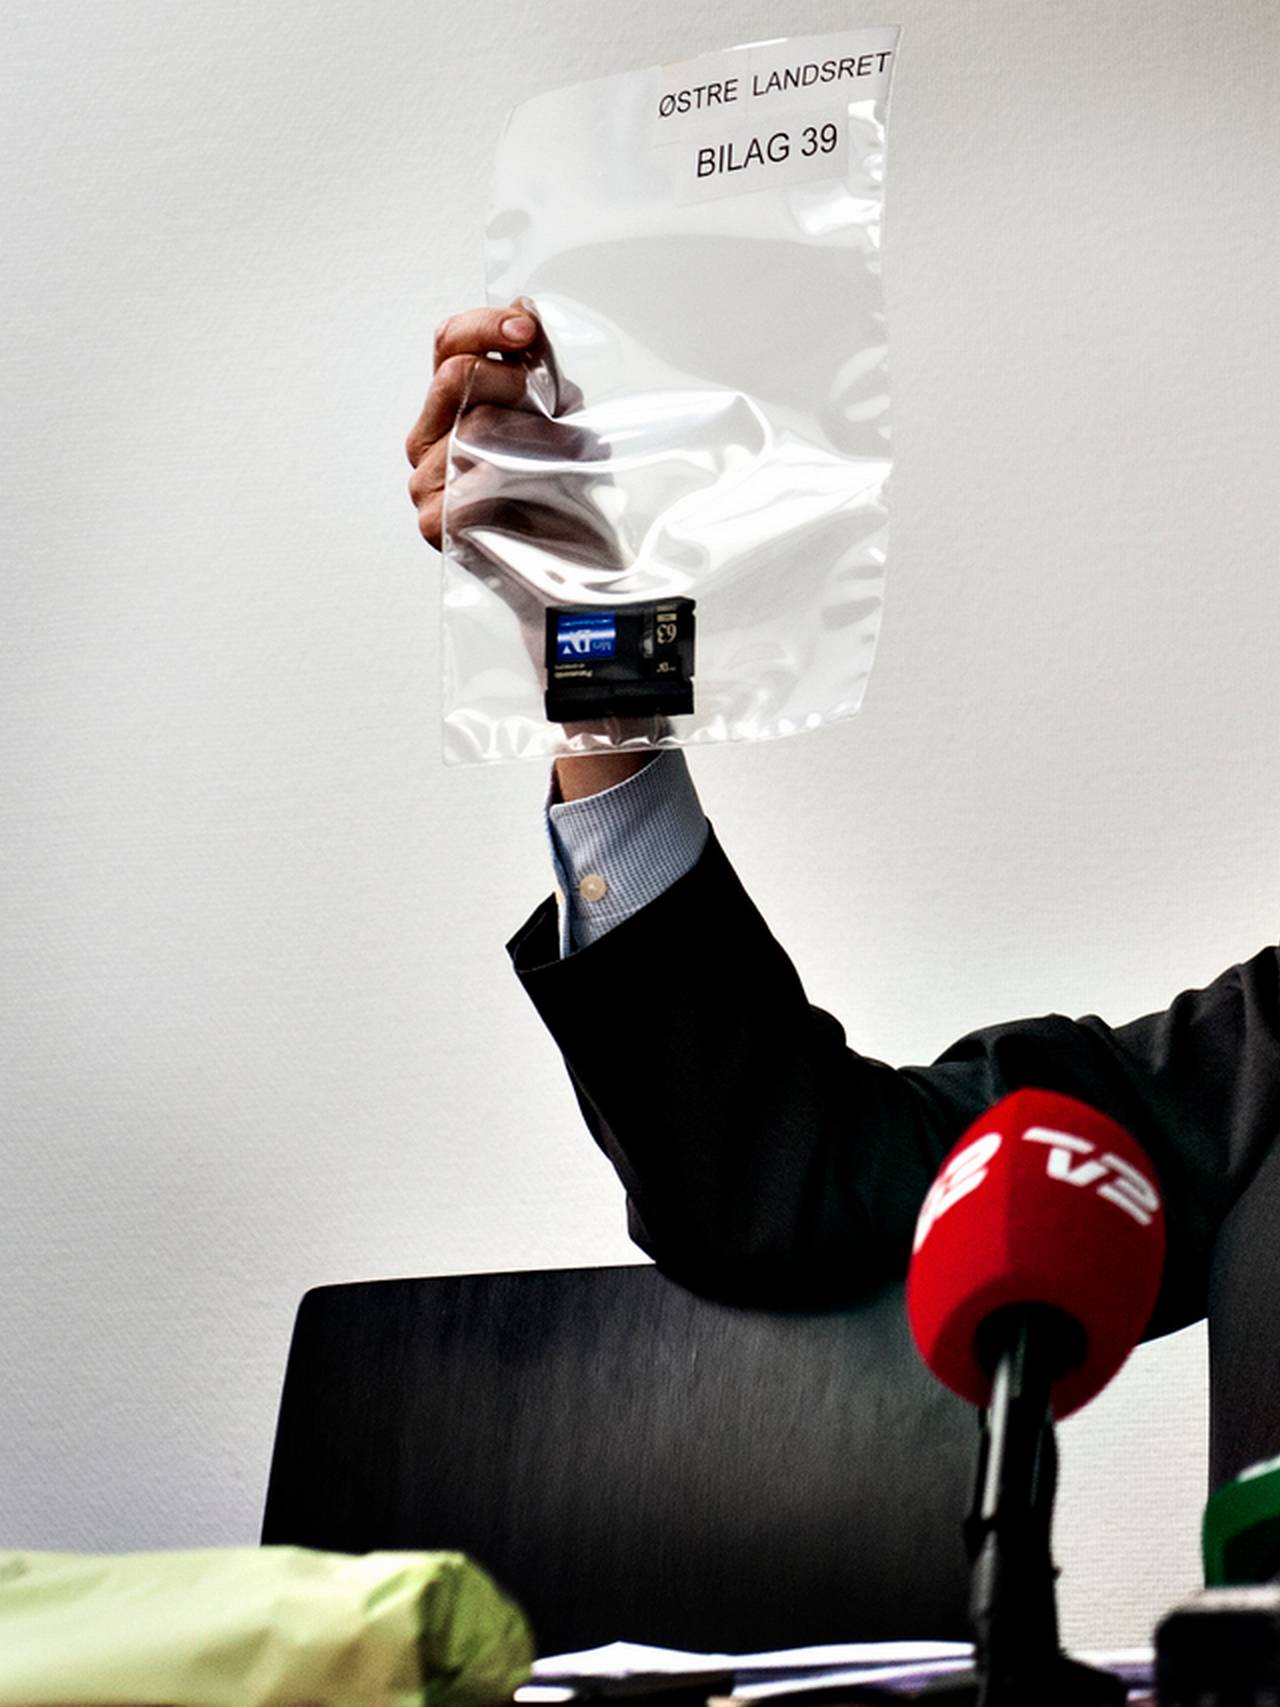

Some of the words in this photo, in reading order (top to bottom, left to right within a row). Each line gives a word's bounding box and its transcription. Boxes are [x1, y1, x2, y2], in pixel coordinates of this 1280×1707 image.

[658, 78, 739, 118] ØSTRE
[752, 51, 892, 97] LANDSRET
[696, 132, 790, 178] BILAG
[801, 123, 838, 157] 39
[1021, 1126, 1160, 1226] TV2
